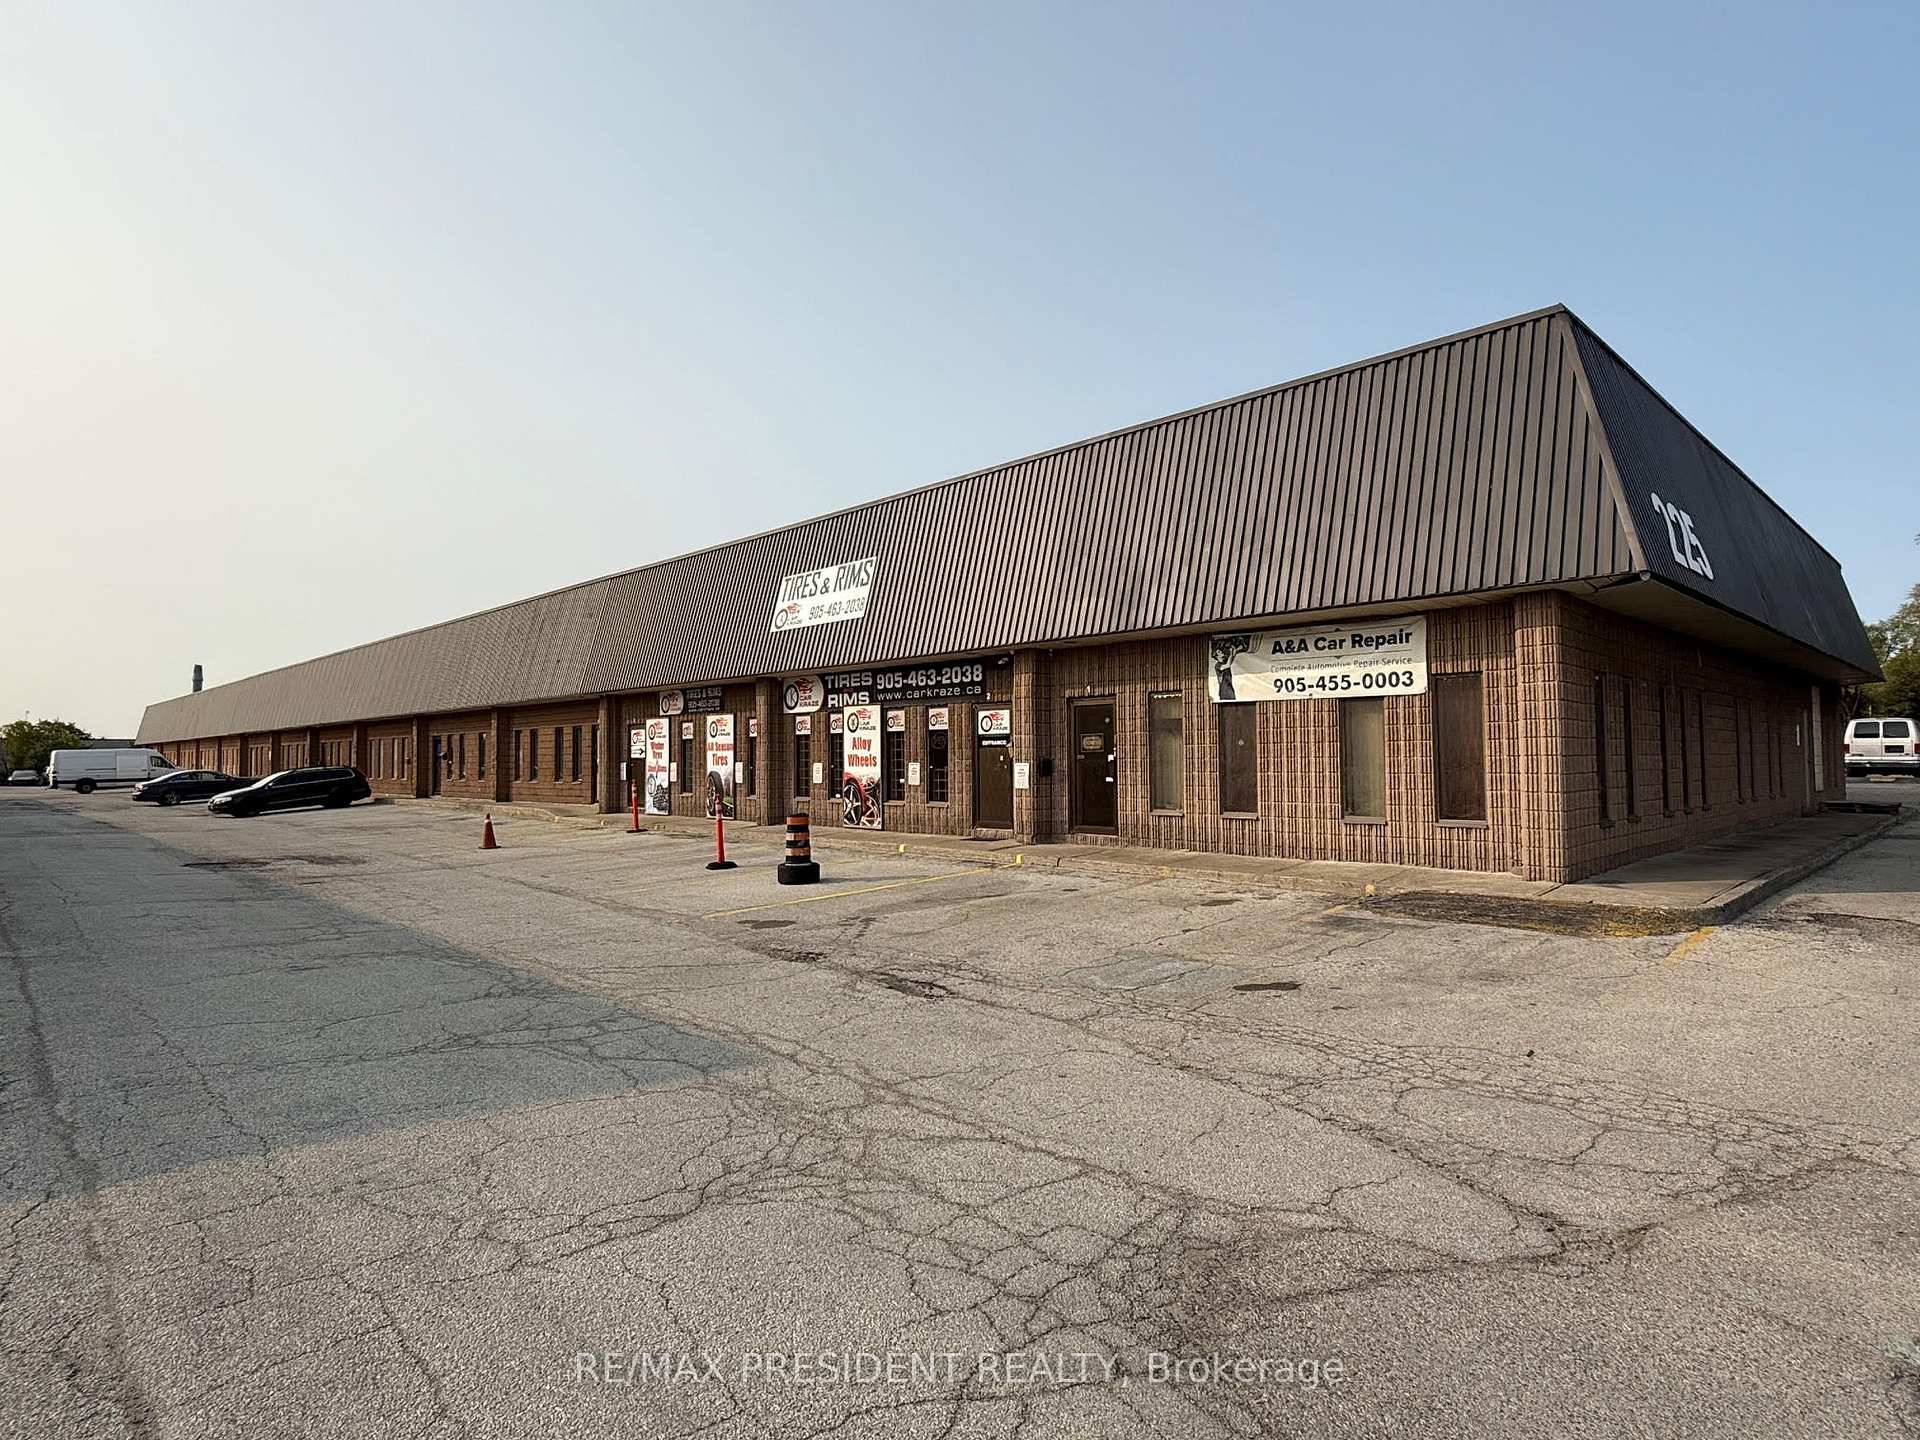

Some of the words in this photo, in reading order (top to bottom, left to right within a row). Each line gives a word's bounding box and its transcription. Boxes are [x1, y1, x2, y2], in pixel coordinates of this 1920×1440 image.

[1651, 492, 1714, 580] 225
[782, 571, 821, 602] TIRES
[820, 577, 830, 595] &
[833, 560, 873, 592] RIMS
[808, 597, 866, 620] 905-463-2038
[1271, 638, 1309, 655] A&A
[1314, 635, 1346, 652] Car
[1351, 629, 1413, 649] Repair
[1353, 659, 1379, 669] Repair
[1381, 656, 1413, 666] Service
[825, 672, 873, 689] TIRES
[876, 664, 983, 690] 905-463-2038
[1273, 671, 1415, 693] 905-455-0003
[828, 691, 870, 708] RIMS
[877, 684, 982, 701] www.carkraze.ca
[852, 737, 872, 751] Alloy
[712, 754, 728, 766] Tires
[848, 754, 877, 767] Wheels
